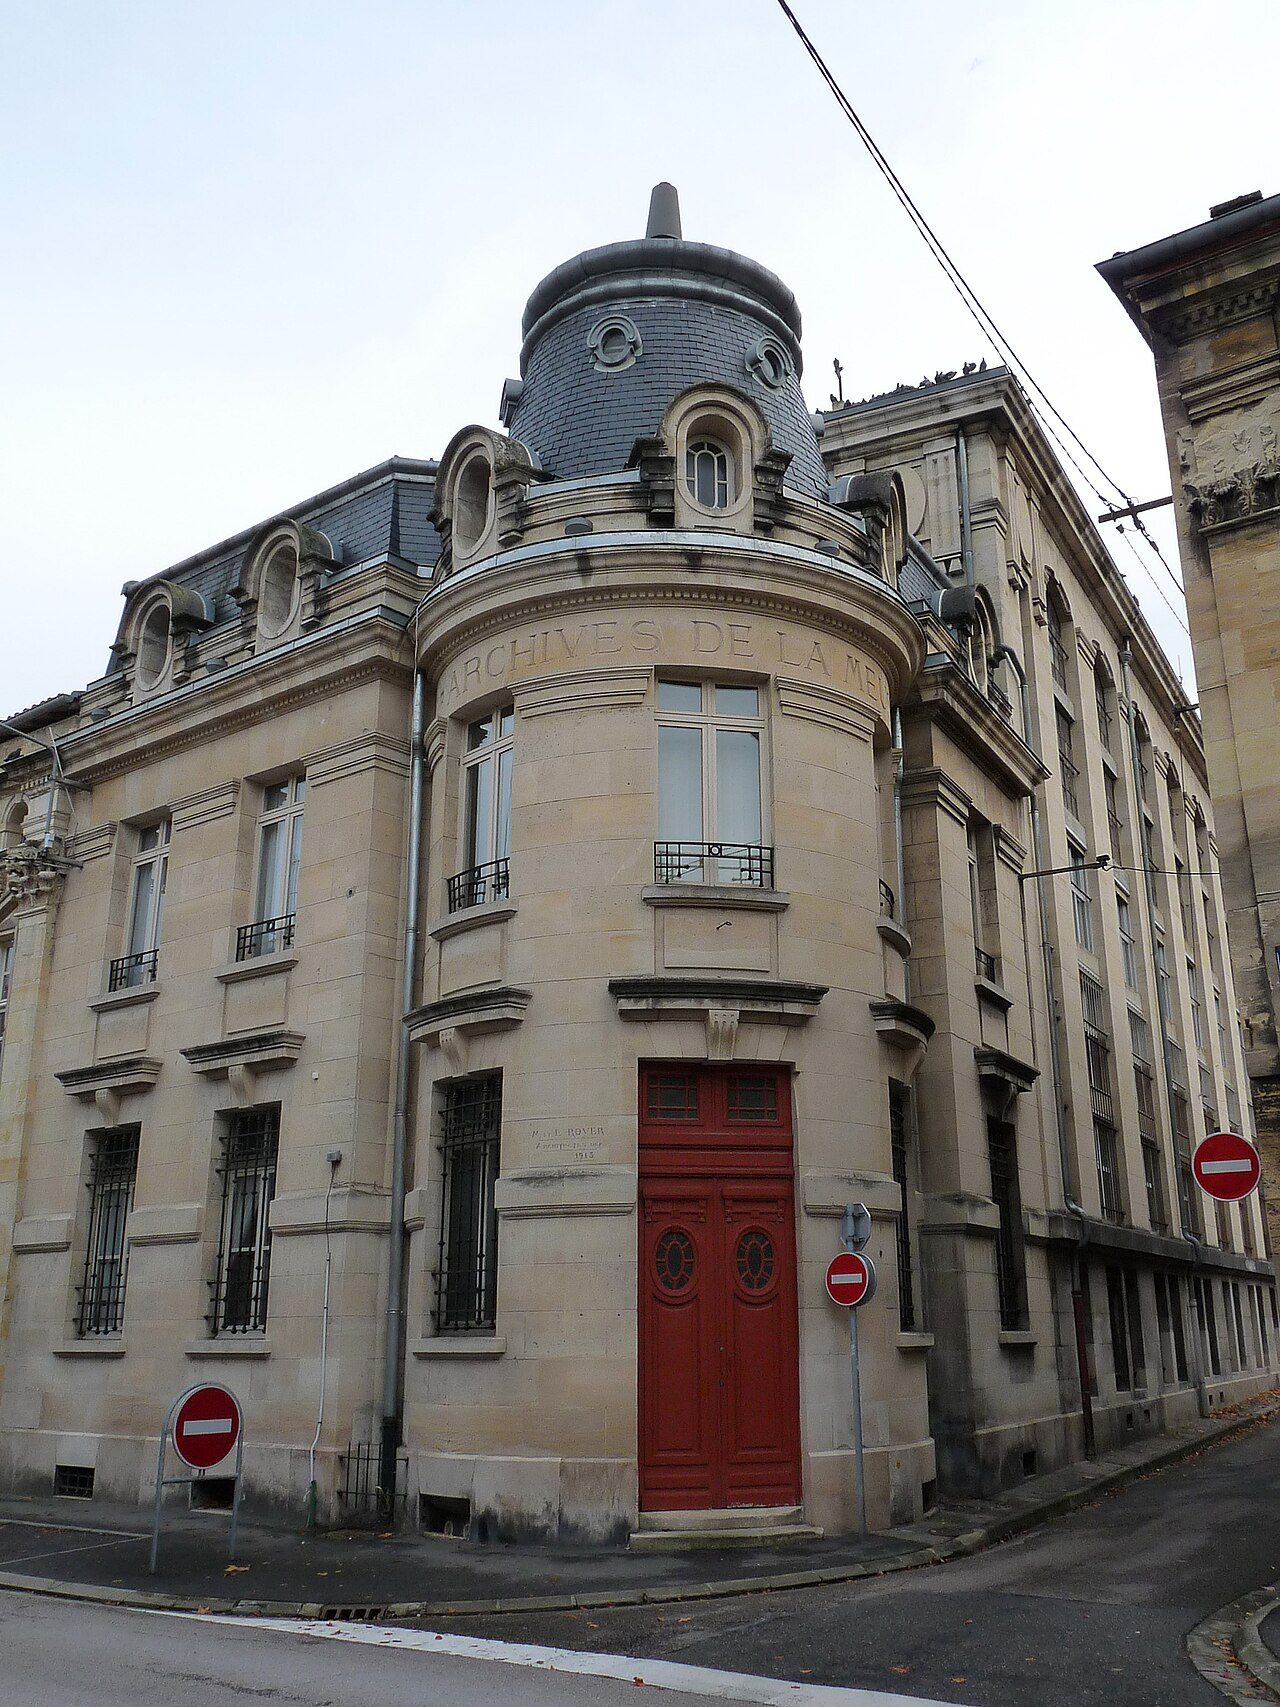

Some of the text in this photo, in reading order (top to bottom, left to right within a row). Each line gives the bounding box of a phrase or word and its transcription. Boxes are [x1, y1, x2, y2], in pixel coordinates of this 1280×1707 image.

[448, 620, 664, 704] ARCHIVES
[691, 620, 754, 657] DE
[776, 631, 832, 677] LA
